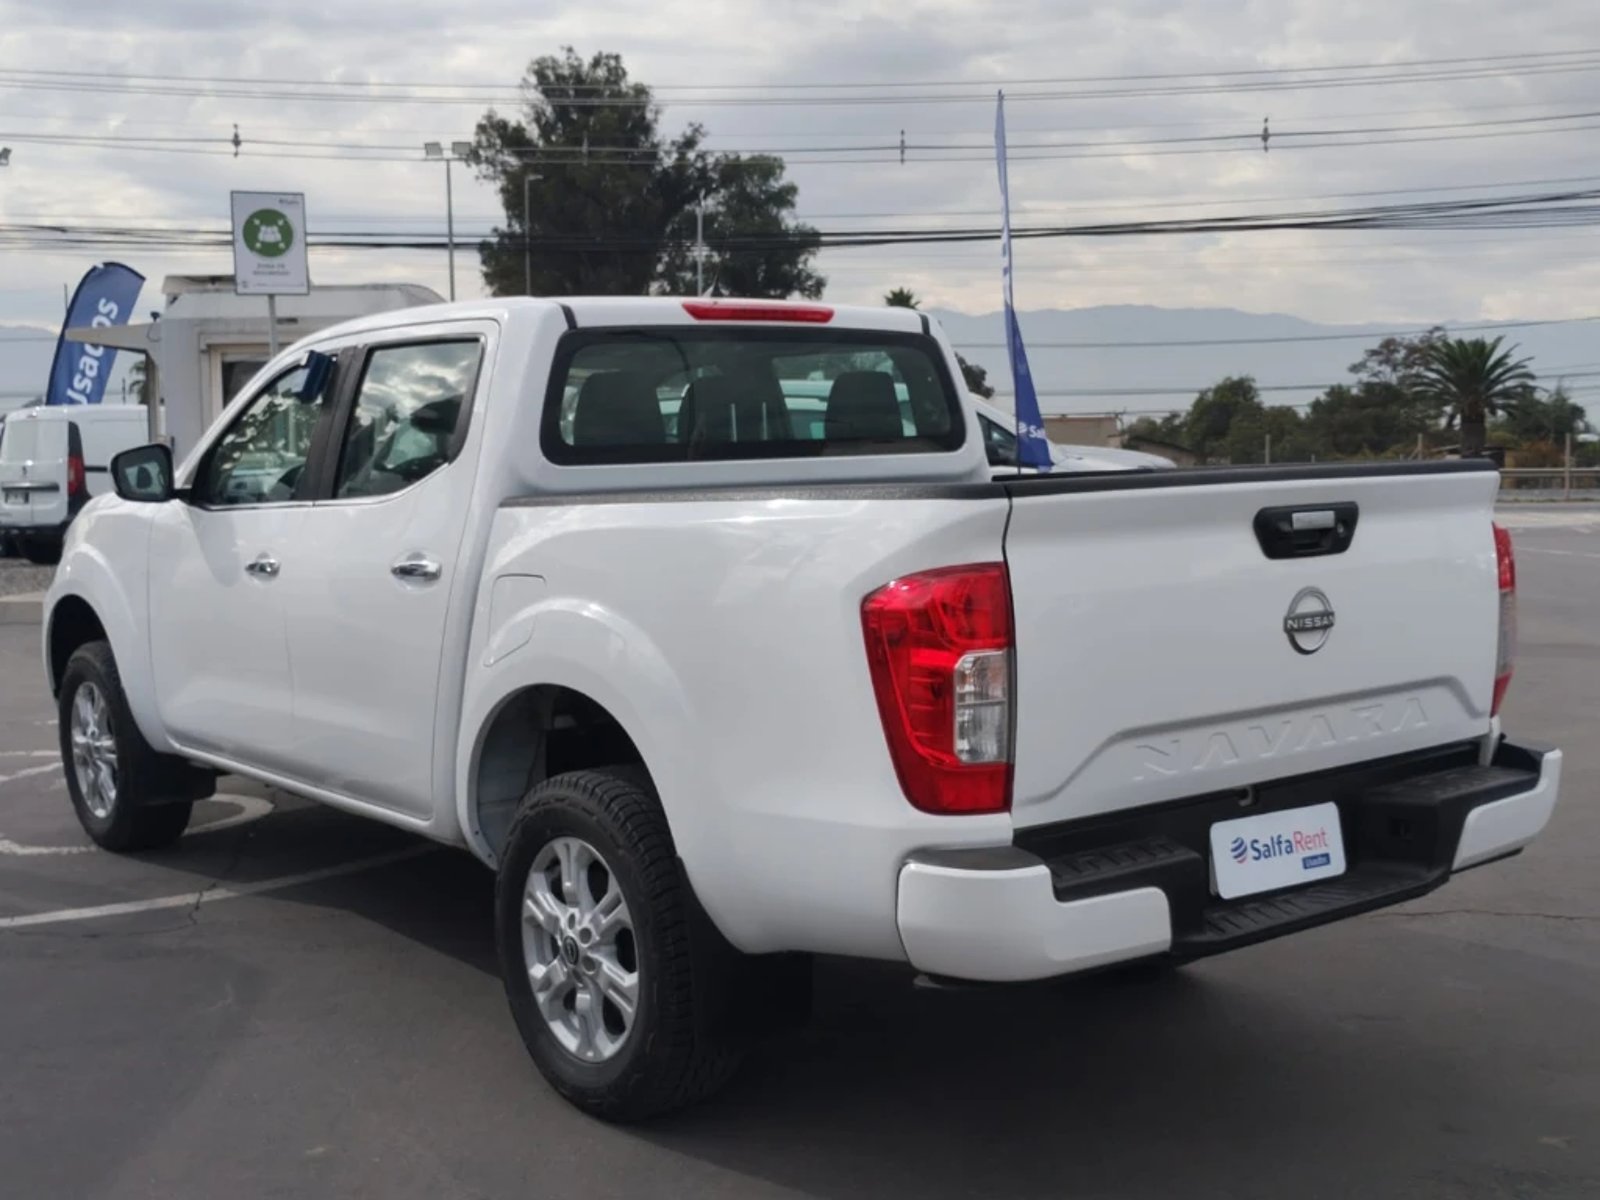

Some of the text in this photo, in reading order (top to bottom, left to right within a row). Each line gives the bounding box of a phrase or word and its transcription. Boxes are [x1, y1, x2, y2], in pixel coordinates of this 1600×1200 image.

[1286, 615, 1335, 630] NISSAN
[1131, 696, 1430, 782] NAVARA
[1250, 827, 1329, 861] SalfaRent
